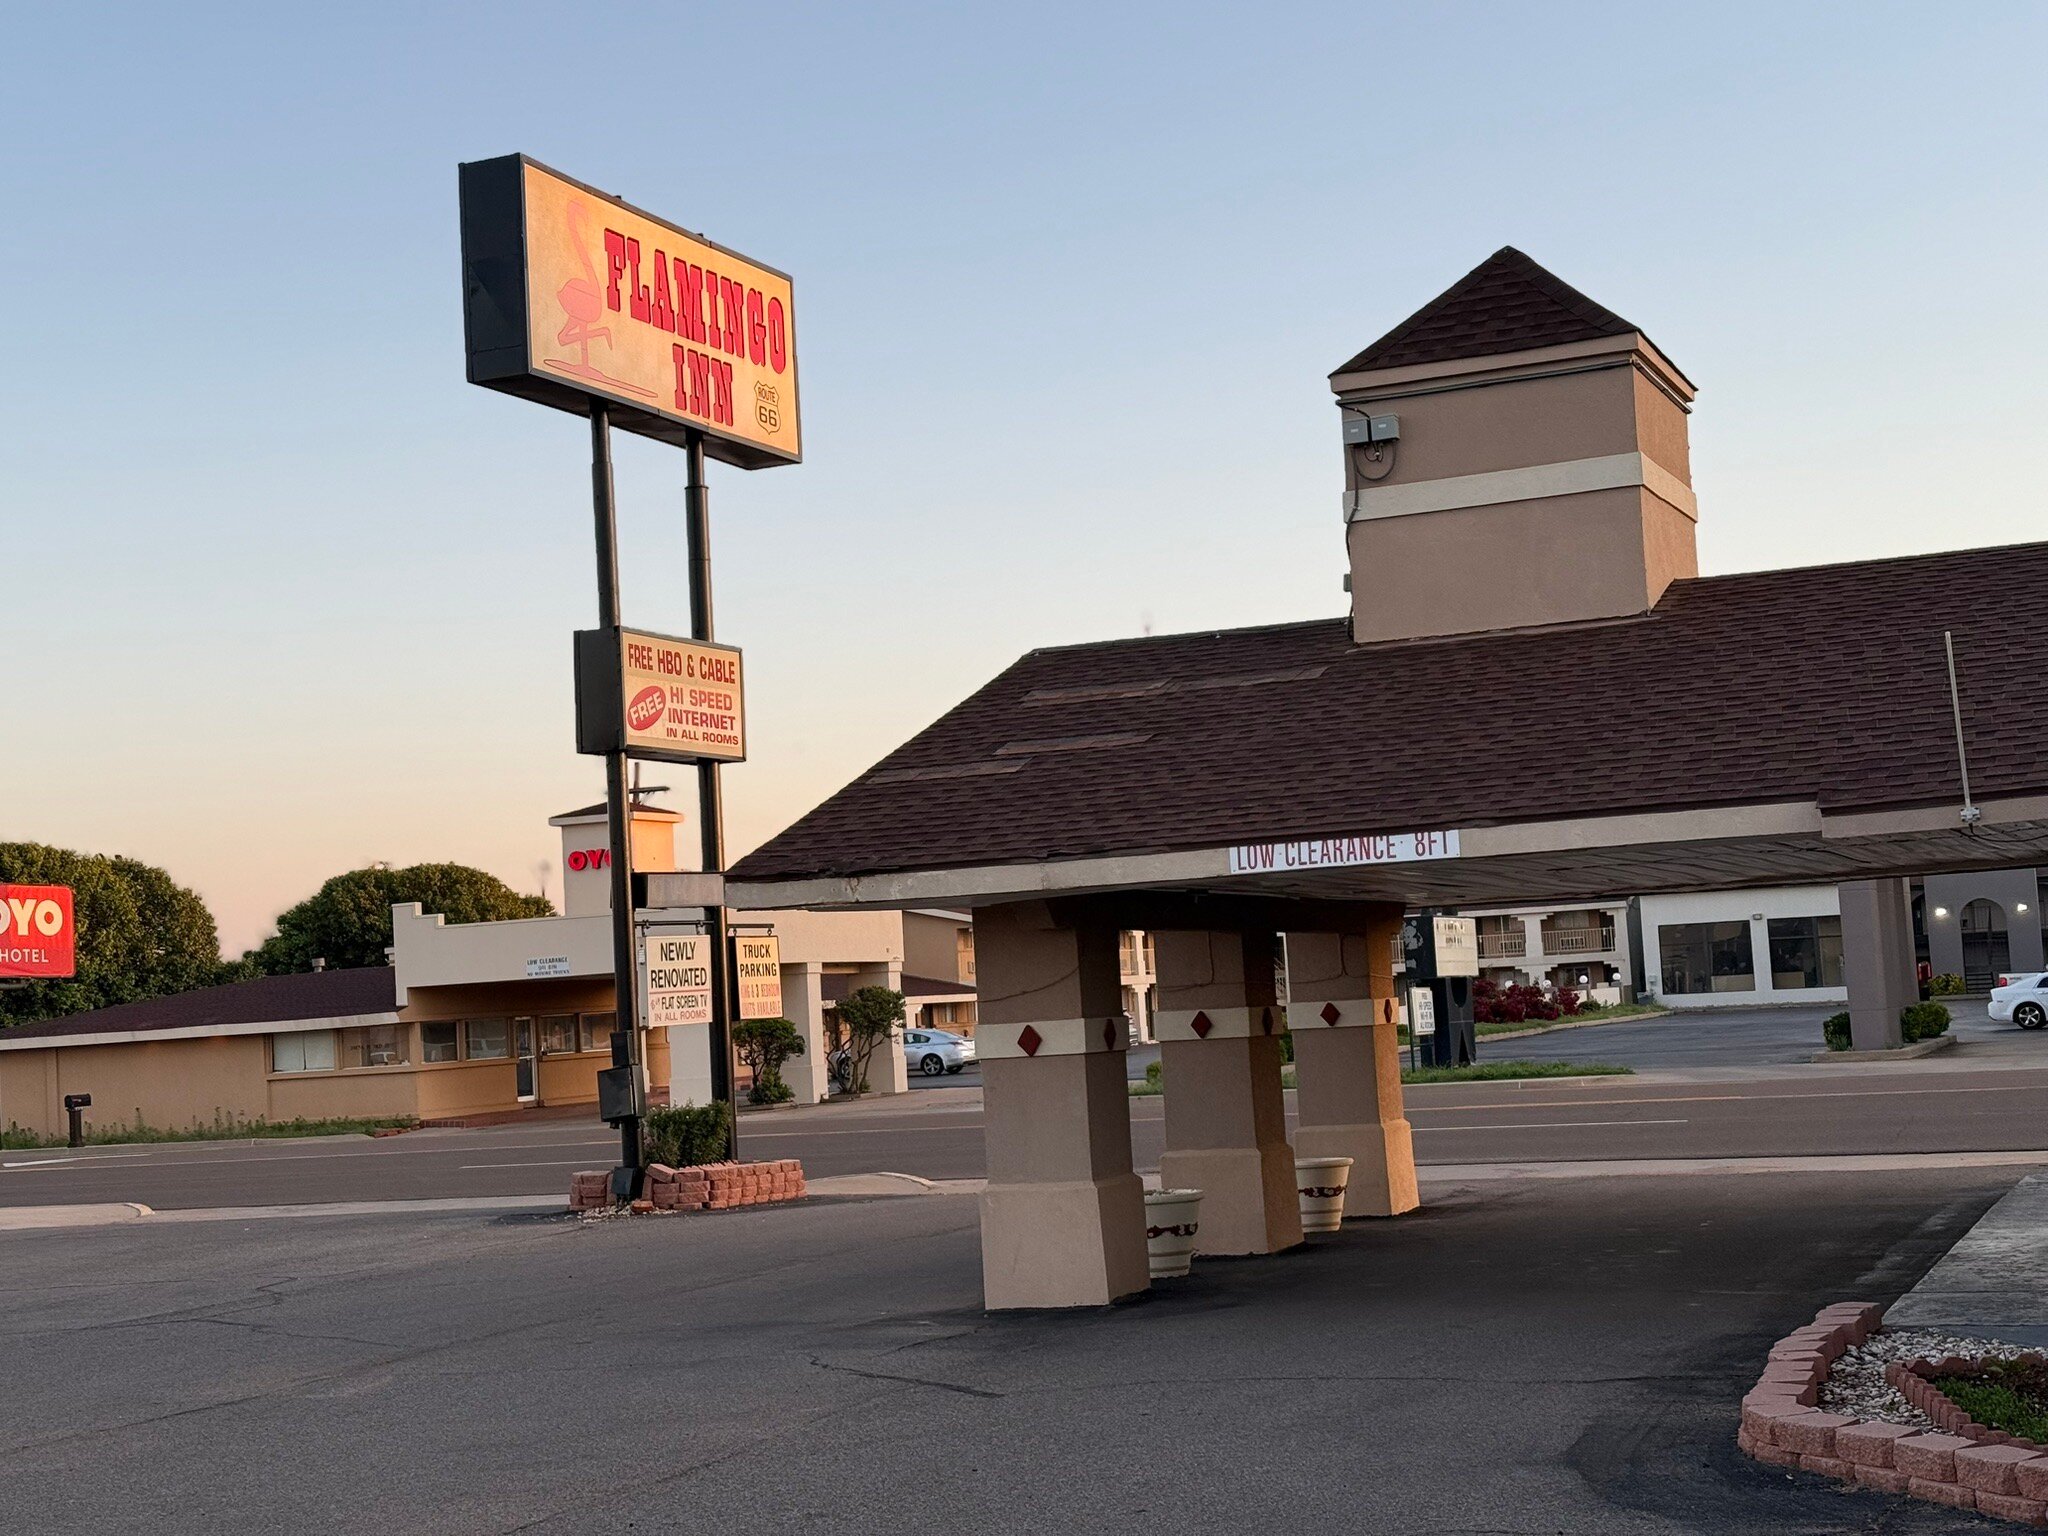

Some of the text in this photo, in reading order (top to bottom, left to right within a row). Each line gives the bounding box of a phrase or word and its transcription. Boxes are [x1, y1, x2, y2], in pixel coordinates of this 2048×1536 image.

[604, 228, 786, 374] FLAMINGO
[673, 343, 734, 427] INN
[757, 386, 776, 403] ROUTE
[759, 405, 777, 428] 66
[628, 643, 735, 684] FREE HBO & CABLE
[629, 691, 664, 725] FREE
[670, 686, 733, 711] HI SPEED
[668, 707, 736, 731] INTERNET
[666, 727, 739, 745] IN ALL ROOMS
[1236, 844, 1275, 871] LOW
[0, 948, 49, 963] HOTEL
[660, 941, 696, 962] NEWLY
[743, 944, 771, 959] TRUCK
[651, 967, 707, 989] RENOVATED
[740, 962, 777, 978] PARKING
[661, 996, 675, 1010] FLAT
[676, 994, 699, 1009] SCREEN
[700, 994, 708, 1008] TV
[655, 1009, 707, 1022] IN ALL ROOMS
